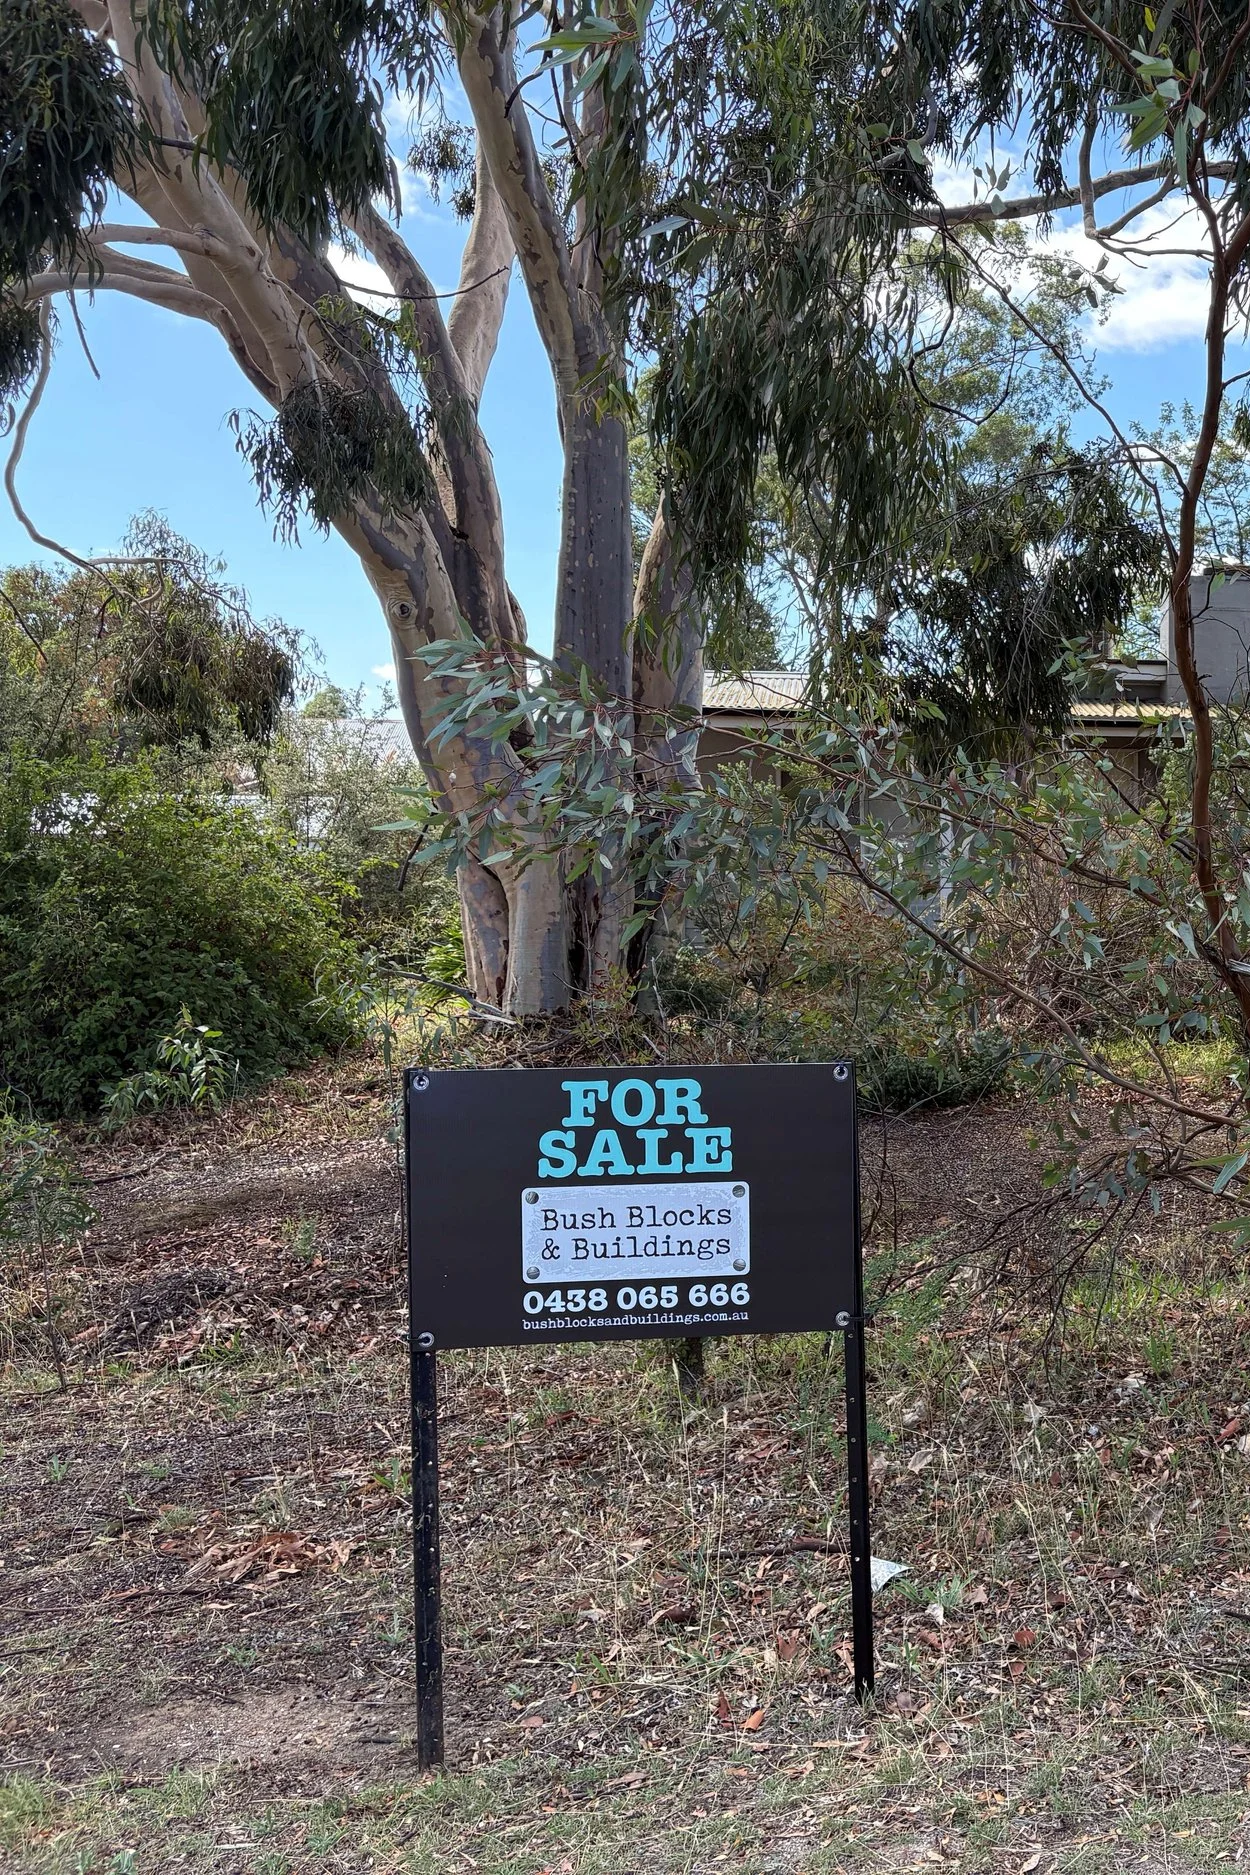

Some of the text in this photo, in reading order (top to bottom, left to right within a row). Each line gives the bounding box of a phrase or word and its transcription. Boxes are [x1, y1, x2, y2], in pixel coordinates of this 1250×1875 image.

[561, 1078, 709, 1127] FOR
[537, 1126, 733, 1178] SALE
[540, 1204, 732, 1231] Bush Blocks
[541, 1234, 731, 1260] & Buildings
[522, 1282, 750, 1315] 0438 065 666
[522, 1311, 749, 1330] bushblocksandbuildings.com.au
